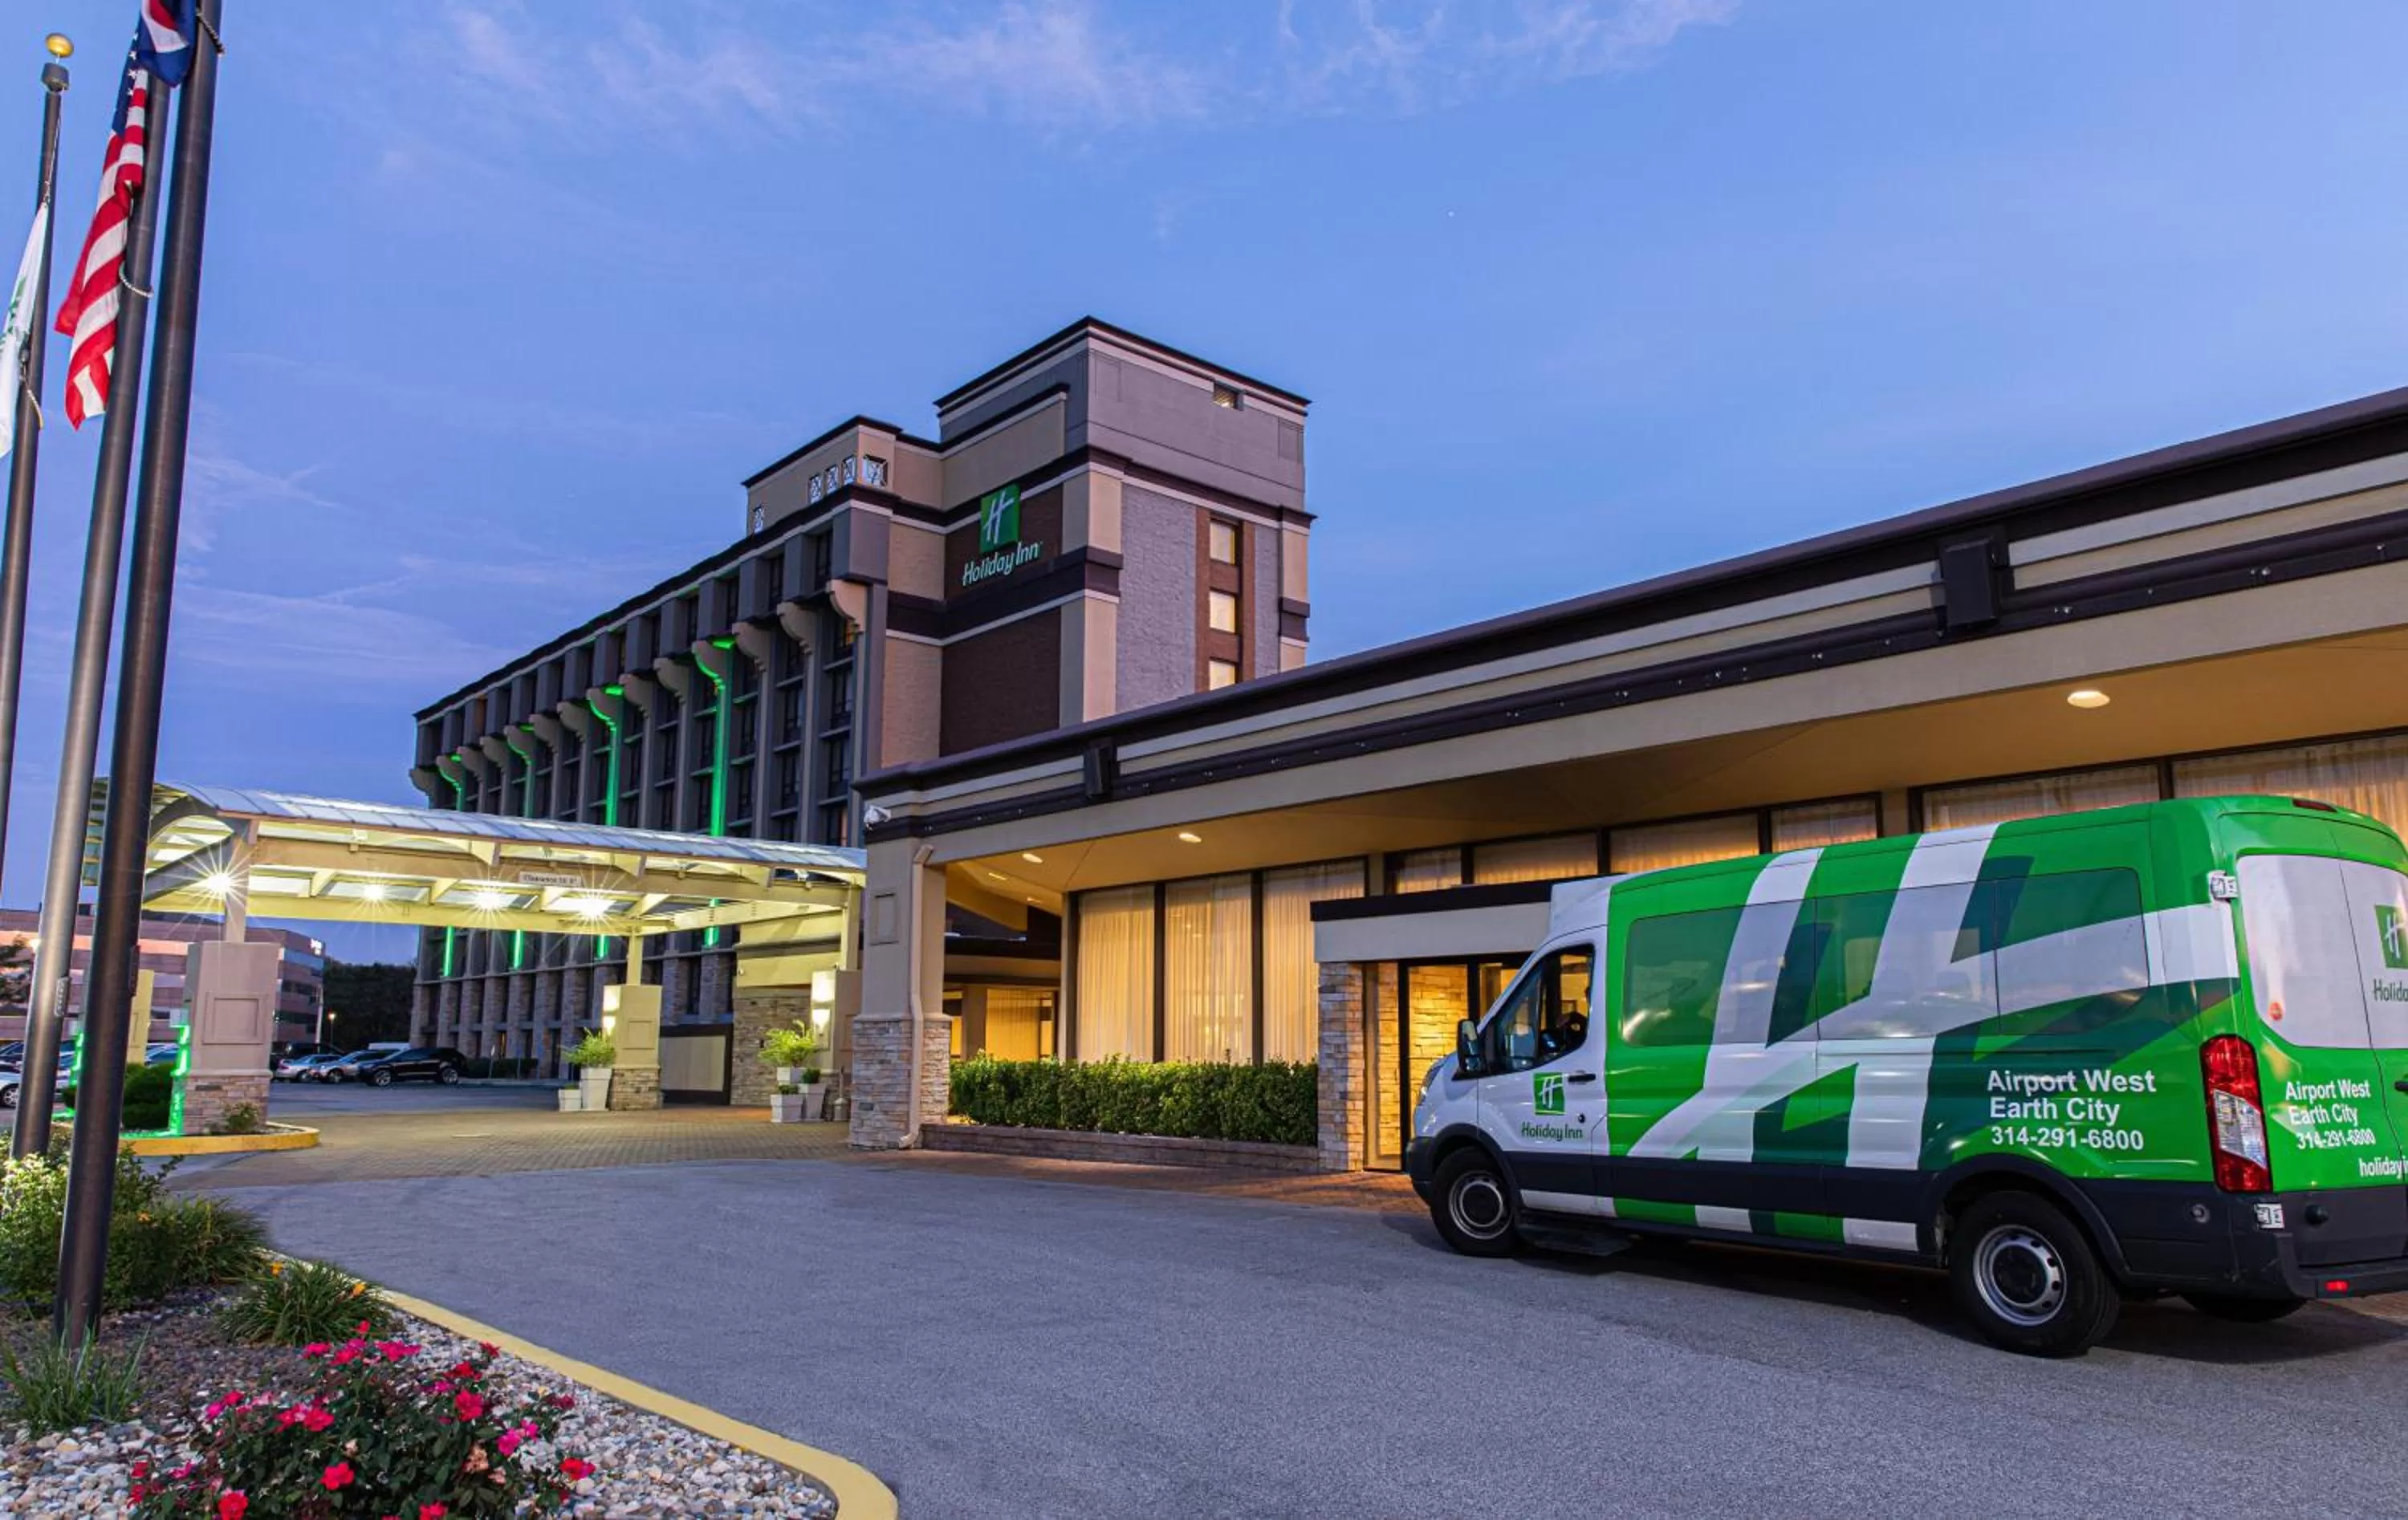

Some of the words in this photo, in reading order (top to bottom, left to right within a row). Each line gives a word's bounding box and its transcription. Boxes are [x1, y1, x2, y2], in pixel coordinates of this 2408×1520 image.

[962, 552, 1015, 586] Holiday
[1015, 542, 1040, 566] Inn
[1987, 1070, 2078, 1096] Airport
[2083, 1070, 2157, 1092] West
[2285, 1080, 2337, 1104] Airport
[2337, 1079, 2371, 1099] West
[1990, 1096, 2058, 1119] Earth
[2066, 1097, 2120, 1127] City
[2288, 1104, 2330, 1125] Earth
[2331, 1103, 2358, 1127] City
[1521, 1122, 1563, 1141] Holiday
[1564, 1124, 1583, 1139] Inn
[1991, 1126, 2144, 1150] 314-291-6800
[2296, 1128, 2376, 1150] 314-291-6800
